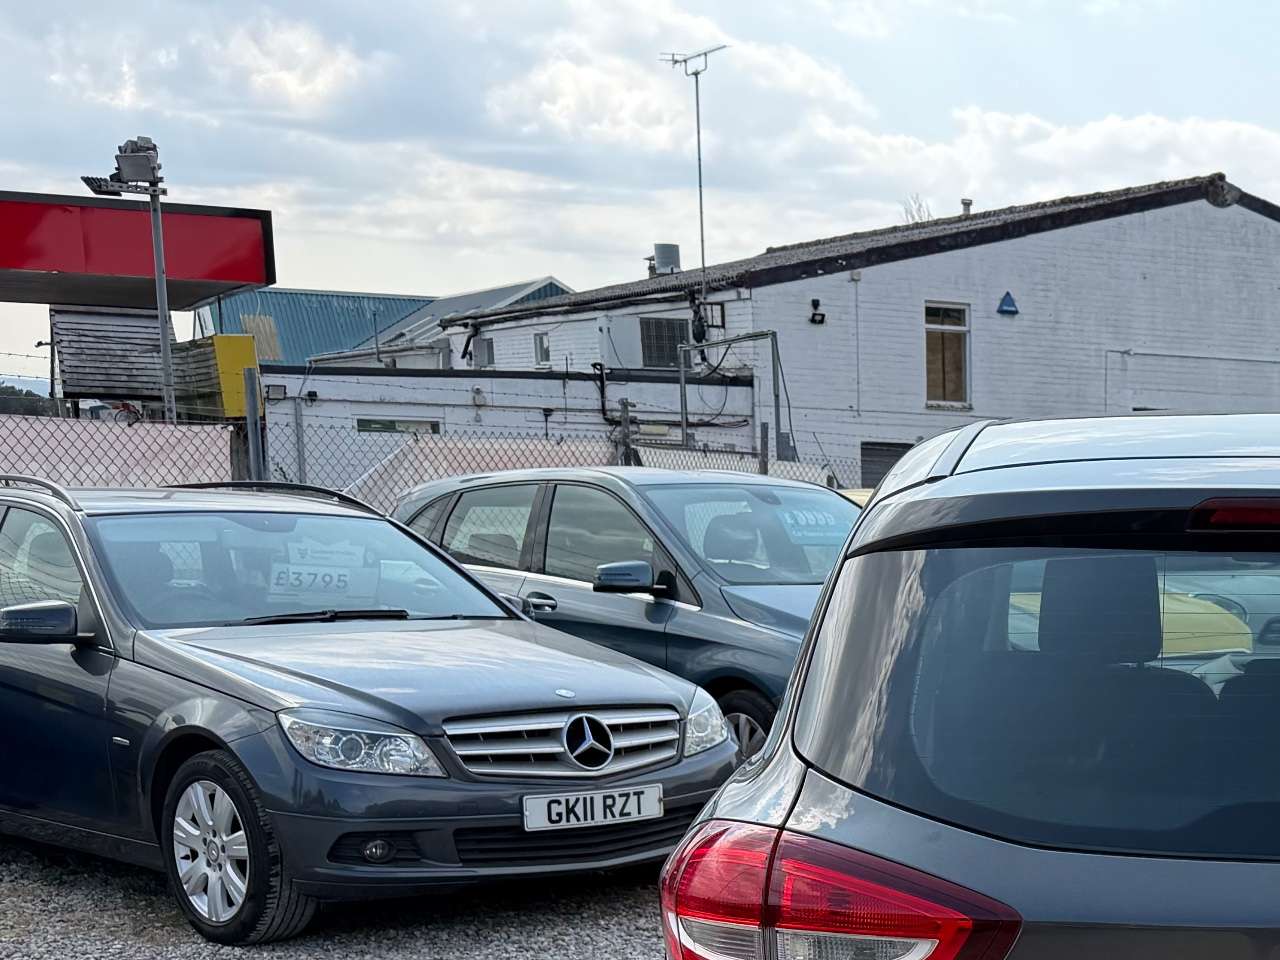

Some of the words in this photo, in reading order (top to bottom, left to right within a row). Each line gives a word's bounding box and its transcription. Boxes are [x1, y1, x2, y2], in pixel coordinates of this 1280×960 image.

[274, 569, 349, 590] £3795
[546, 796, 596, 825] GK11
[602, 791, 645, 819] RZT
